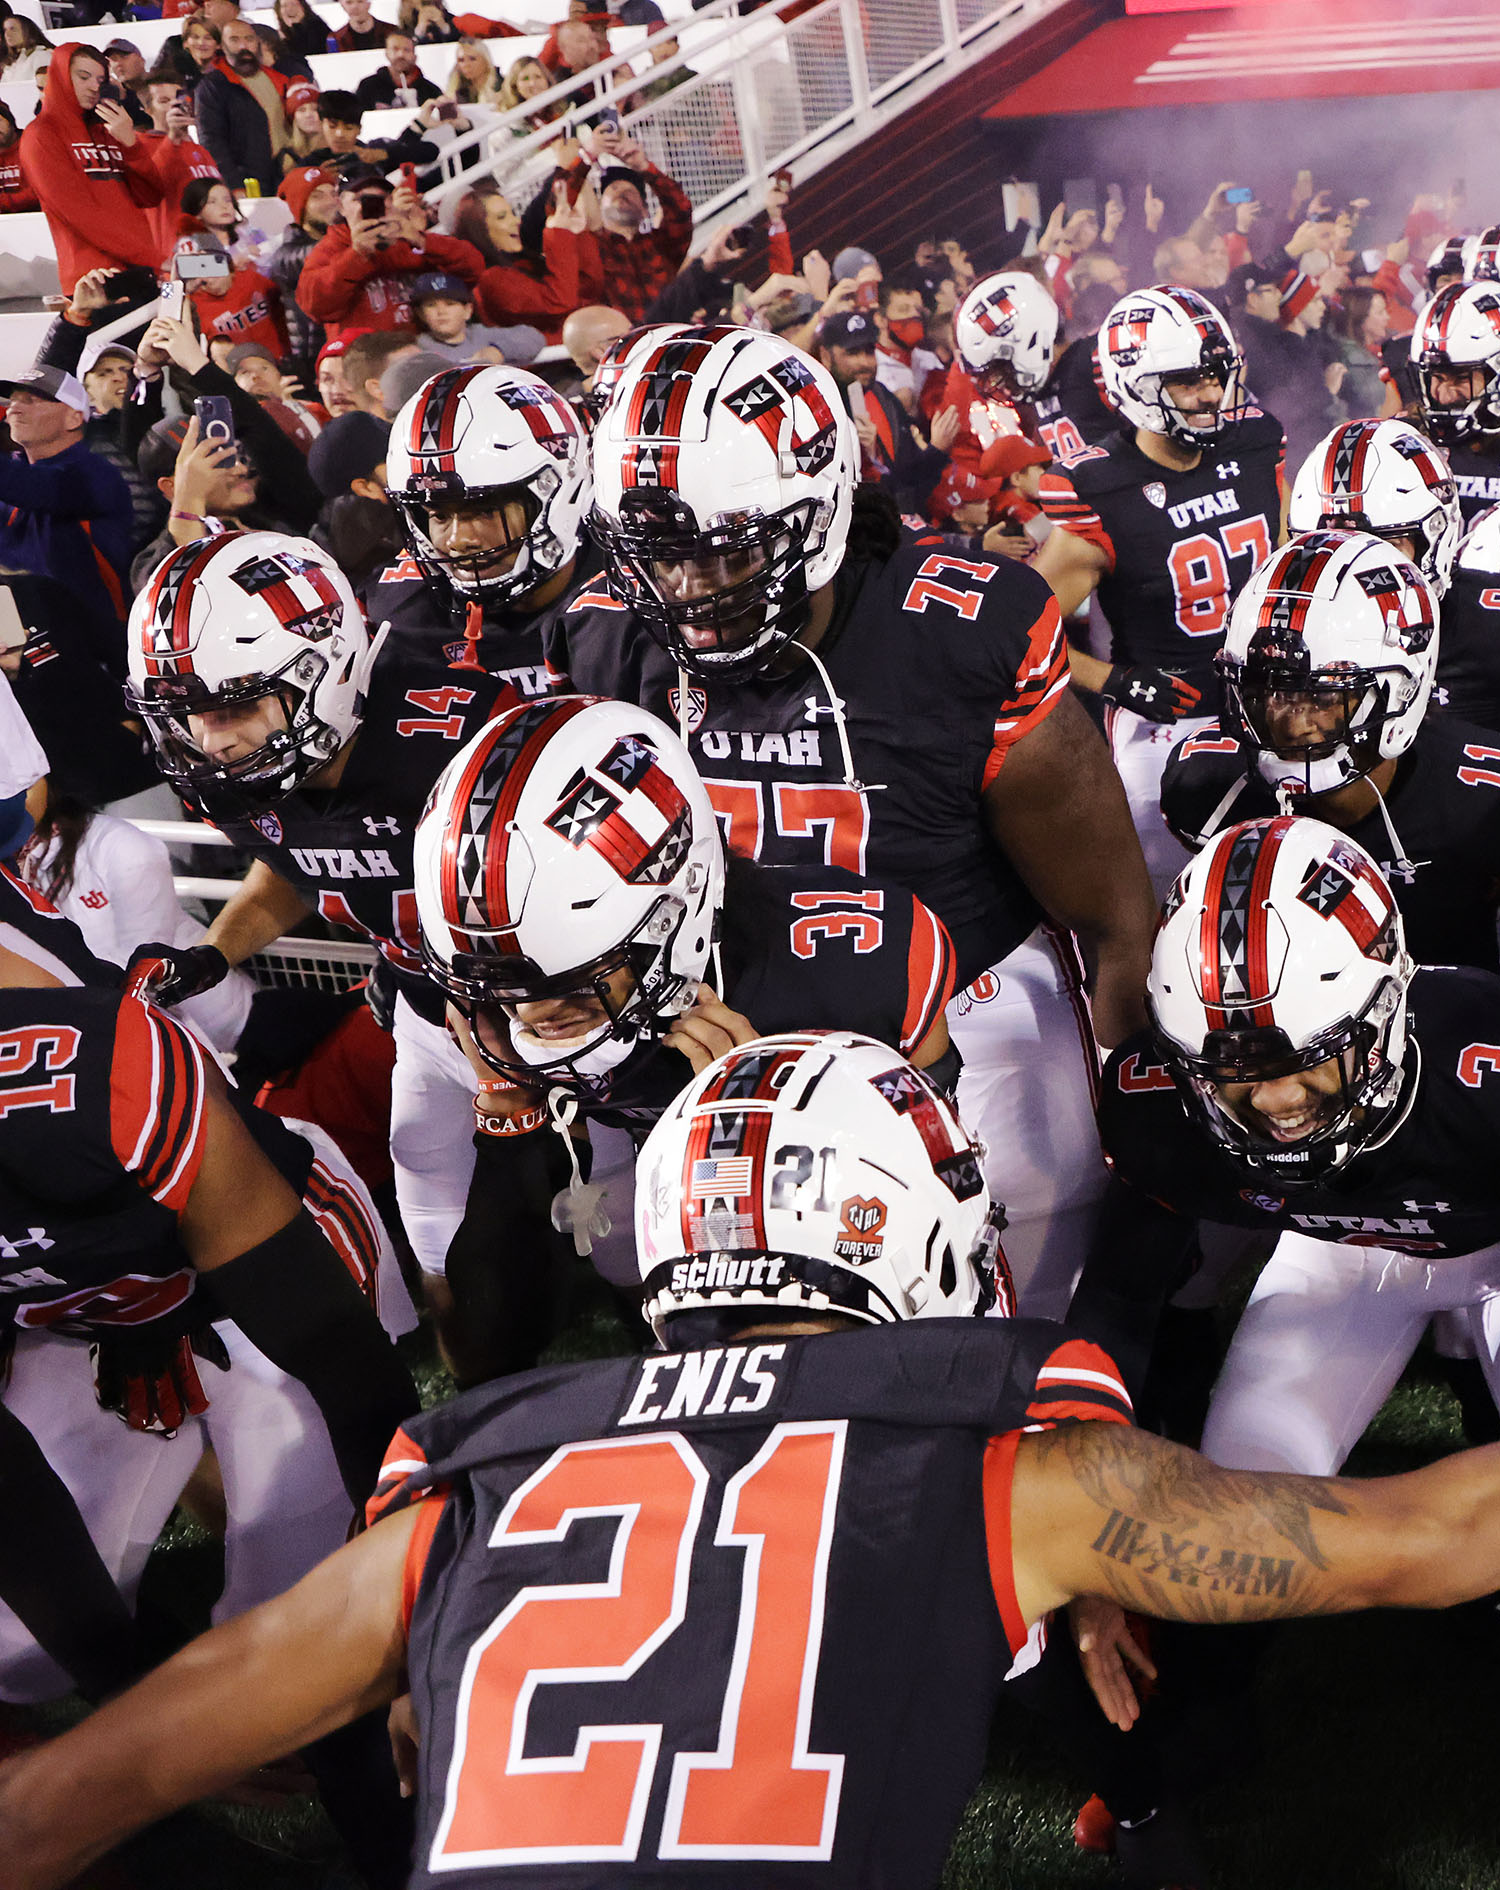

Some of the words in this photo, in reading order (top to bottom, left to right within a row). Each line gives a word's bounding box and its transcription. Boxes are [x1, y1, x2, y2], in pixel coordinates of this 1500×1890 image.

[1167, 488, 1240, 528] UTAH
[1167, 513, 1272, 637] 87
[700, 730, 823, 766] UTAH
[289, 848, 400, 879] UTAH
[475, 1112, 518, 1133] FCA
[769, 1144, 837, 1213] 21
[1289, 1213, 1435, 1234] UTAH
[834, 1240, 883, 1258] FOREVER
[671, 1253, 786, 1291] schutt
[617, 1344, 787, 1426] ENIS
[428, 1419, 849, 1873] 21
